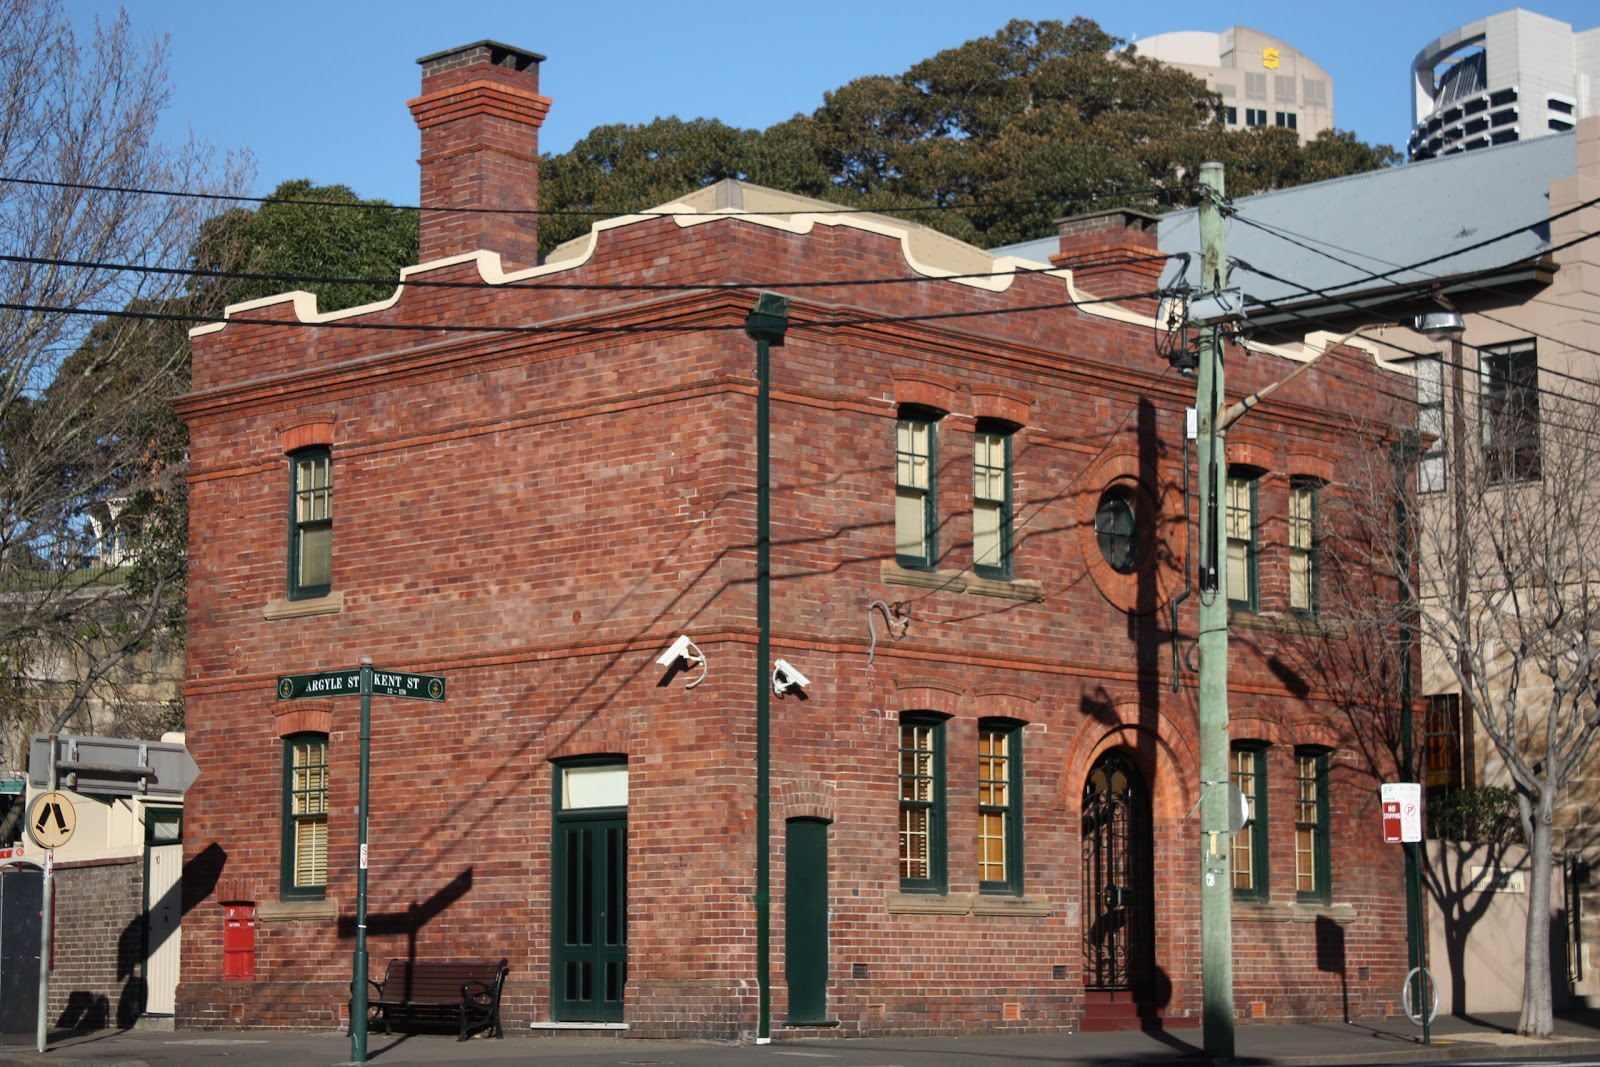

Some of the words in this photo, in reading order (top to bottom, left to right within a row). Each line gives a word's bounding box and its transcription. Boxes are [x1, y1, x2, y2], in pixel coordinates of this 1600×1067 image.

[305, 677, 343, 692] ARGYLE
[347, 676, 360, 688] ST
[374, 673, 402, 688] KENT
[407, 677, 420, 690] ST
[1387, 804, 1397, 813] NO
